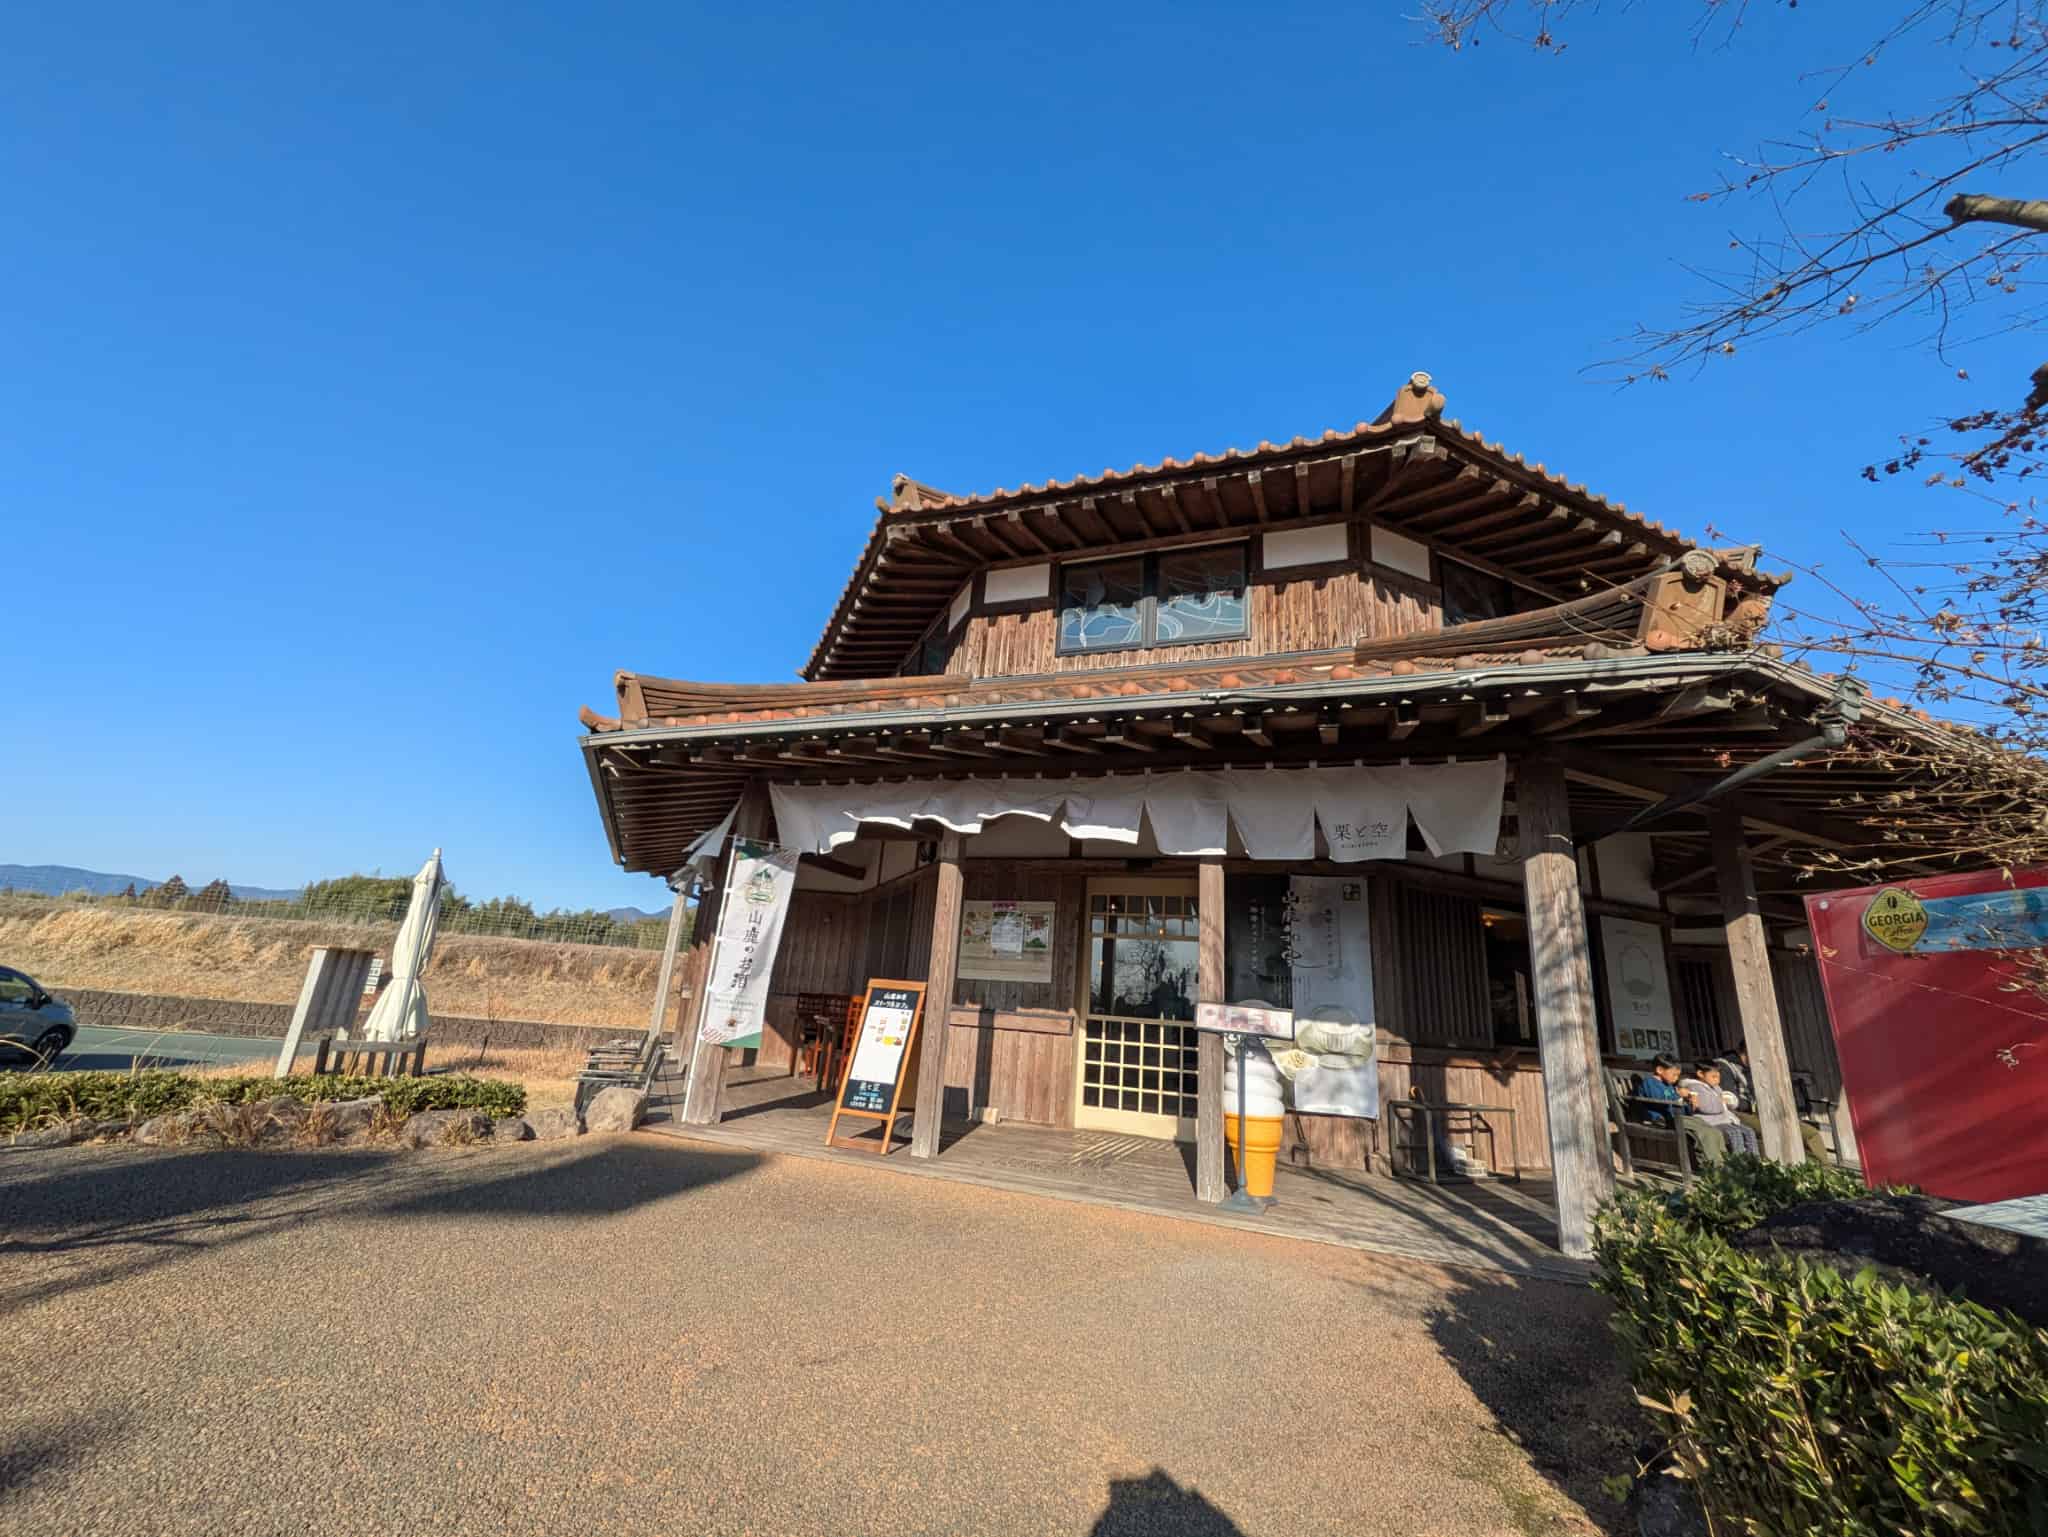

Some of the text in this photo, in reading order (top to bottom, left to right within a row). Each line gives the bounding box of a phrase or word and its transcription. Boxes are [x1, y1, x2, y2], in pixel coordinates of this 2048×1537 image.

[1333, 822, 1392, 841] 栗と空
[1868, 912, 1925, 928] GEORGIA
